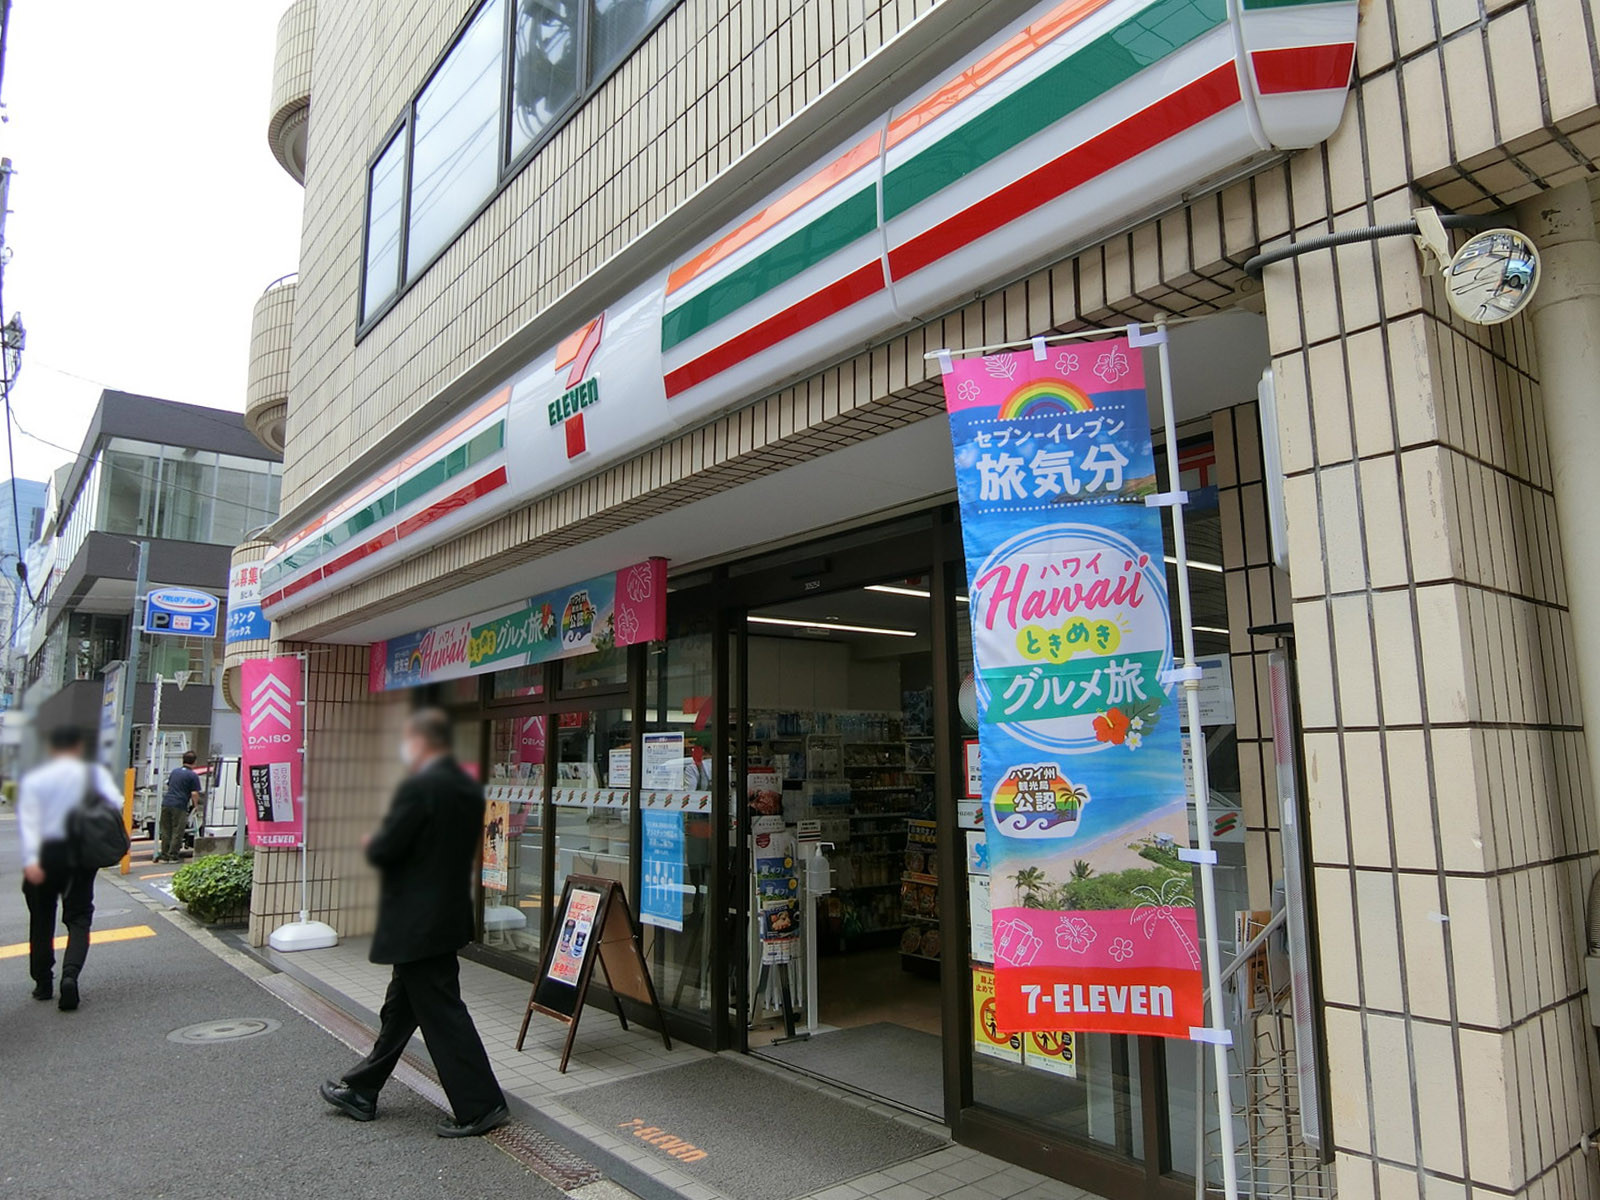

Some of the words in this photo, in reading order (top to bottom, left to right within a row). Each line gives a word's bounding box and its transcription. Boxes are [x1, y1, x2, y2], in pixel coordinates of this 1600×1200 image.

[976, 443, 1129, 501] 旅気分
[1040, 552, 1102, 579] ハワイ
[976, 555, 1148, 630] Hawaii
[152, 612, 170, 629] P
[497, 611, 543, 653] グルメ旅
[419, 622, 471, 678] Hawaii
[1026, 622, 1110, 658] ときめき
[1002, 658, 1147, 715] グルメ旅
[248, 734, 291, 745] DAISO
[1009, 767, 1056, 781] ハワイ州
[1014, 791, 1056, 812] 公認
